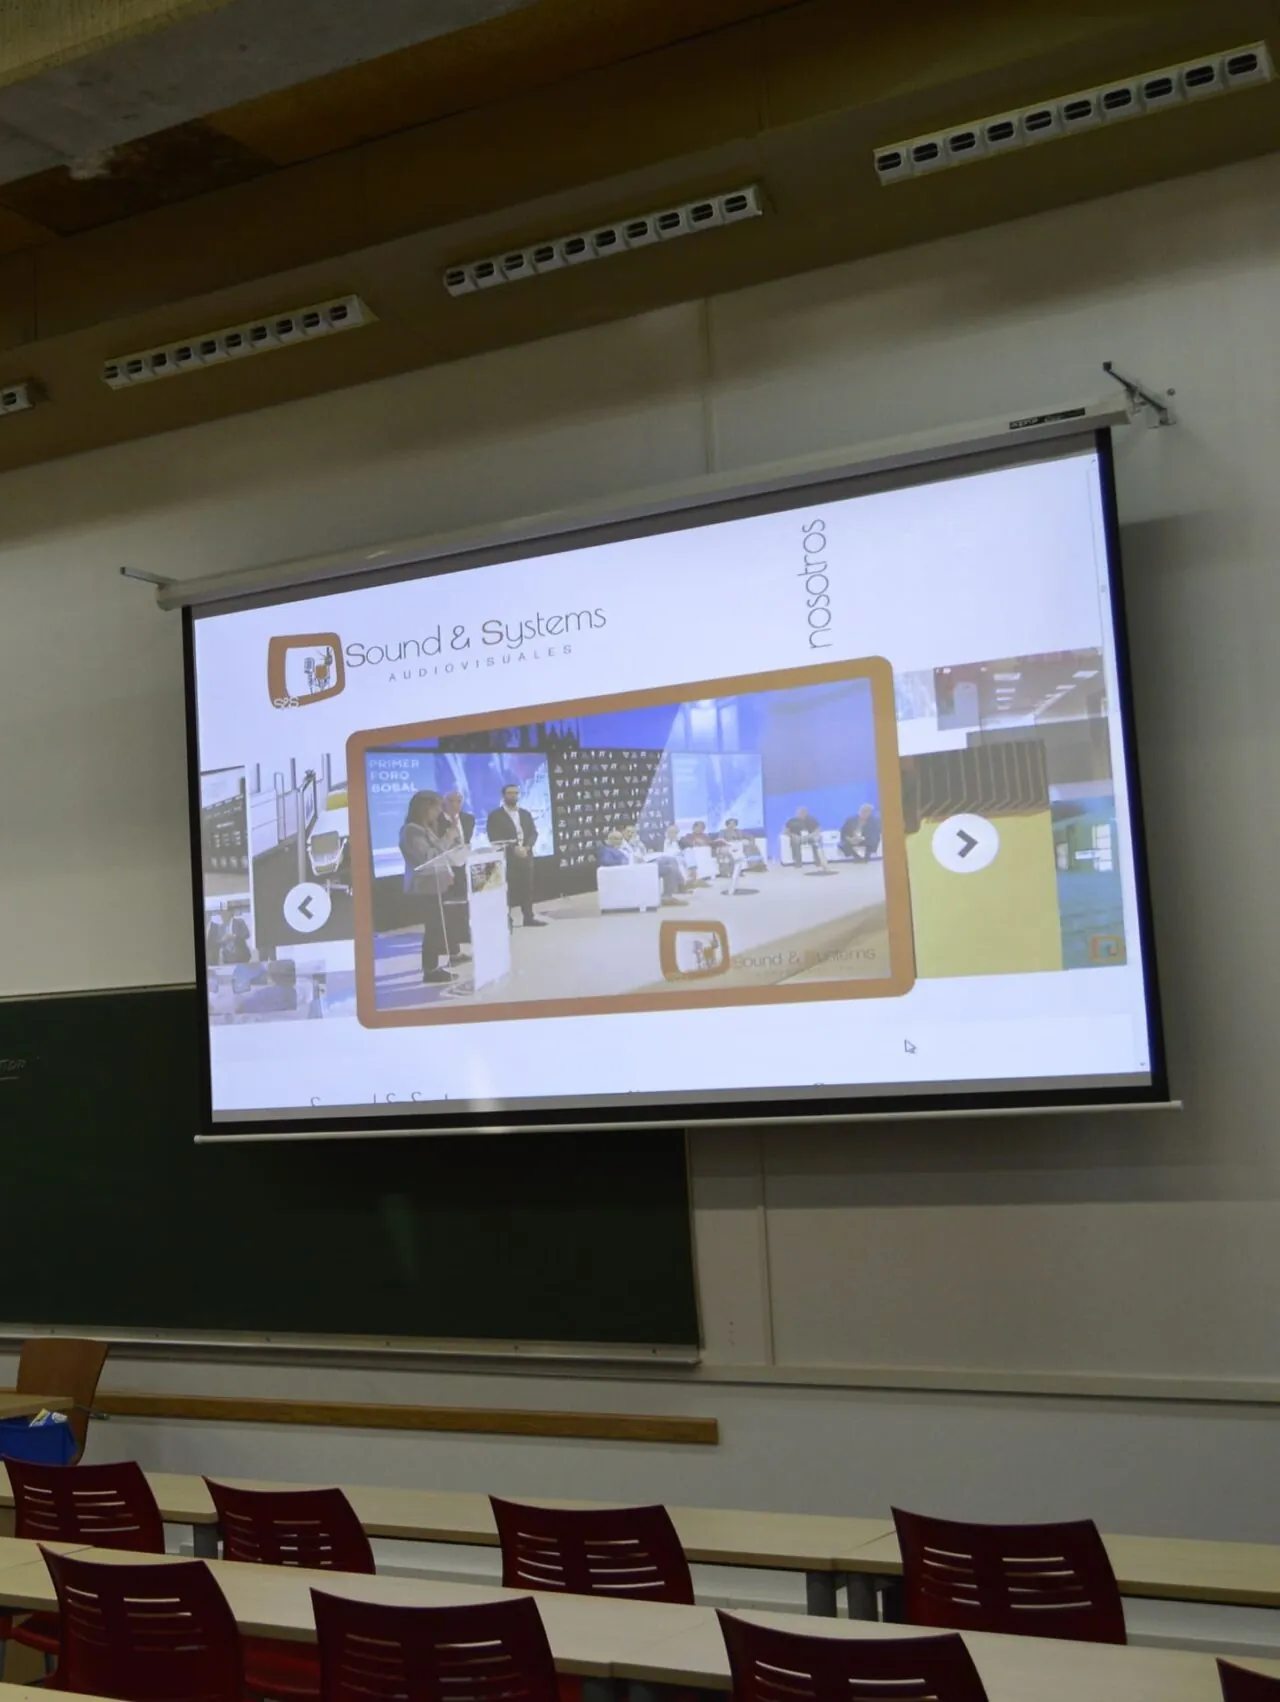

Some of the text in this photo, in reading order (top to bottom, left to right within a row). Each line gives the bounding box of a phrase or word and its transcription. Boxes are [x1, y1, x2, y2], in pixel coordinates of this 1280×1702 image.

[797, 518, 833, 649] nosotros
[345, 608, 606, 668] Sound & Systems
[389, 644, 573, 682] AUDIOVISUALES
